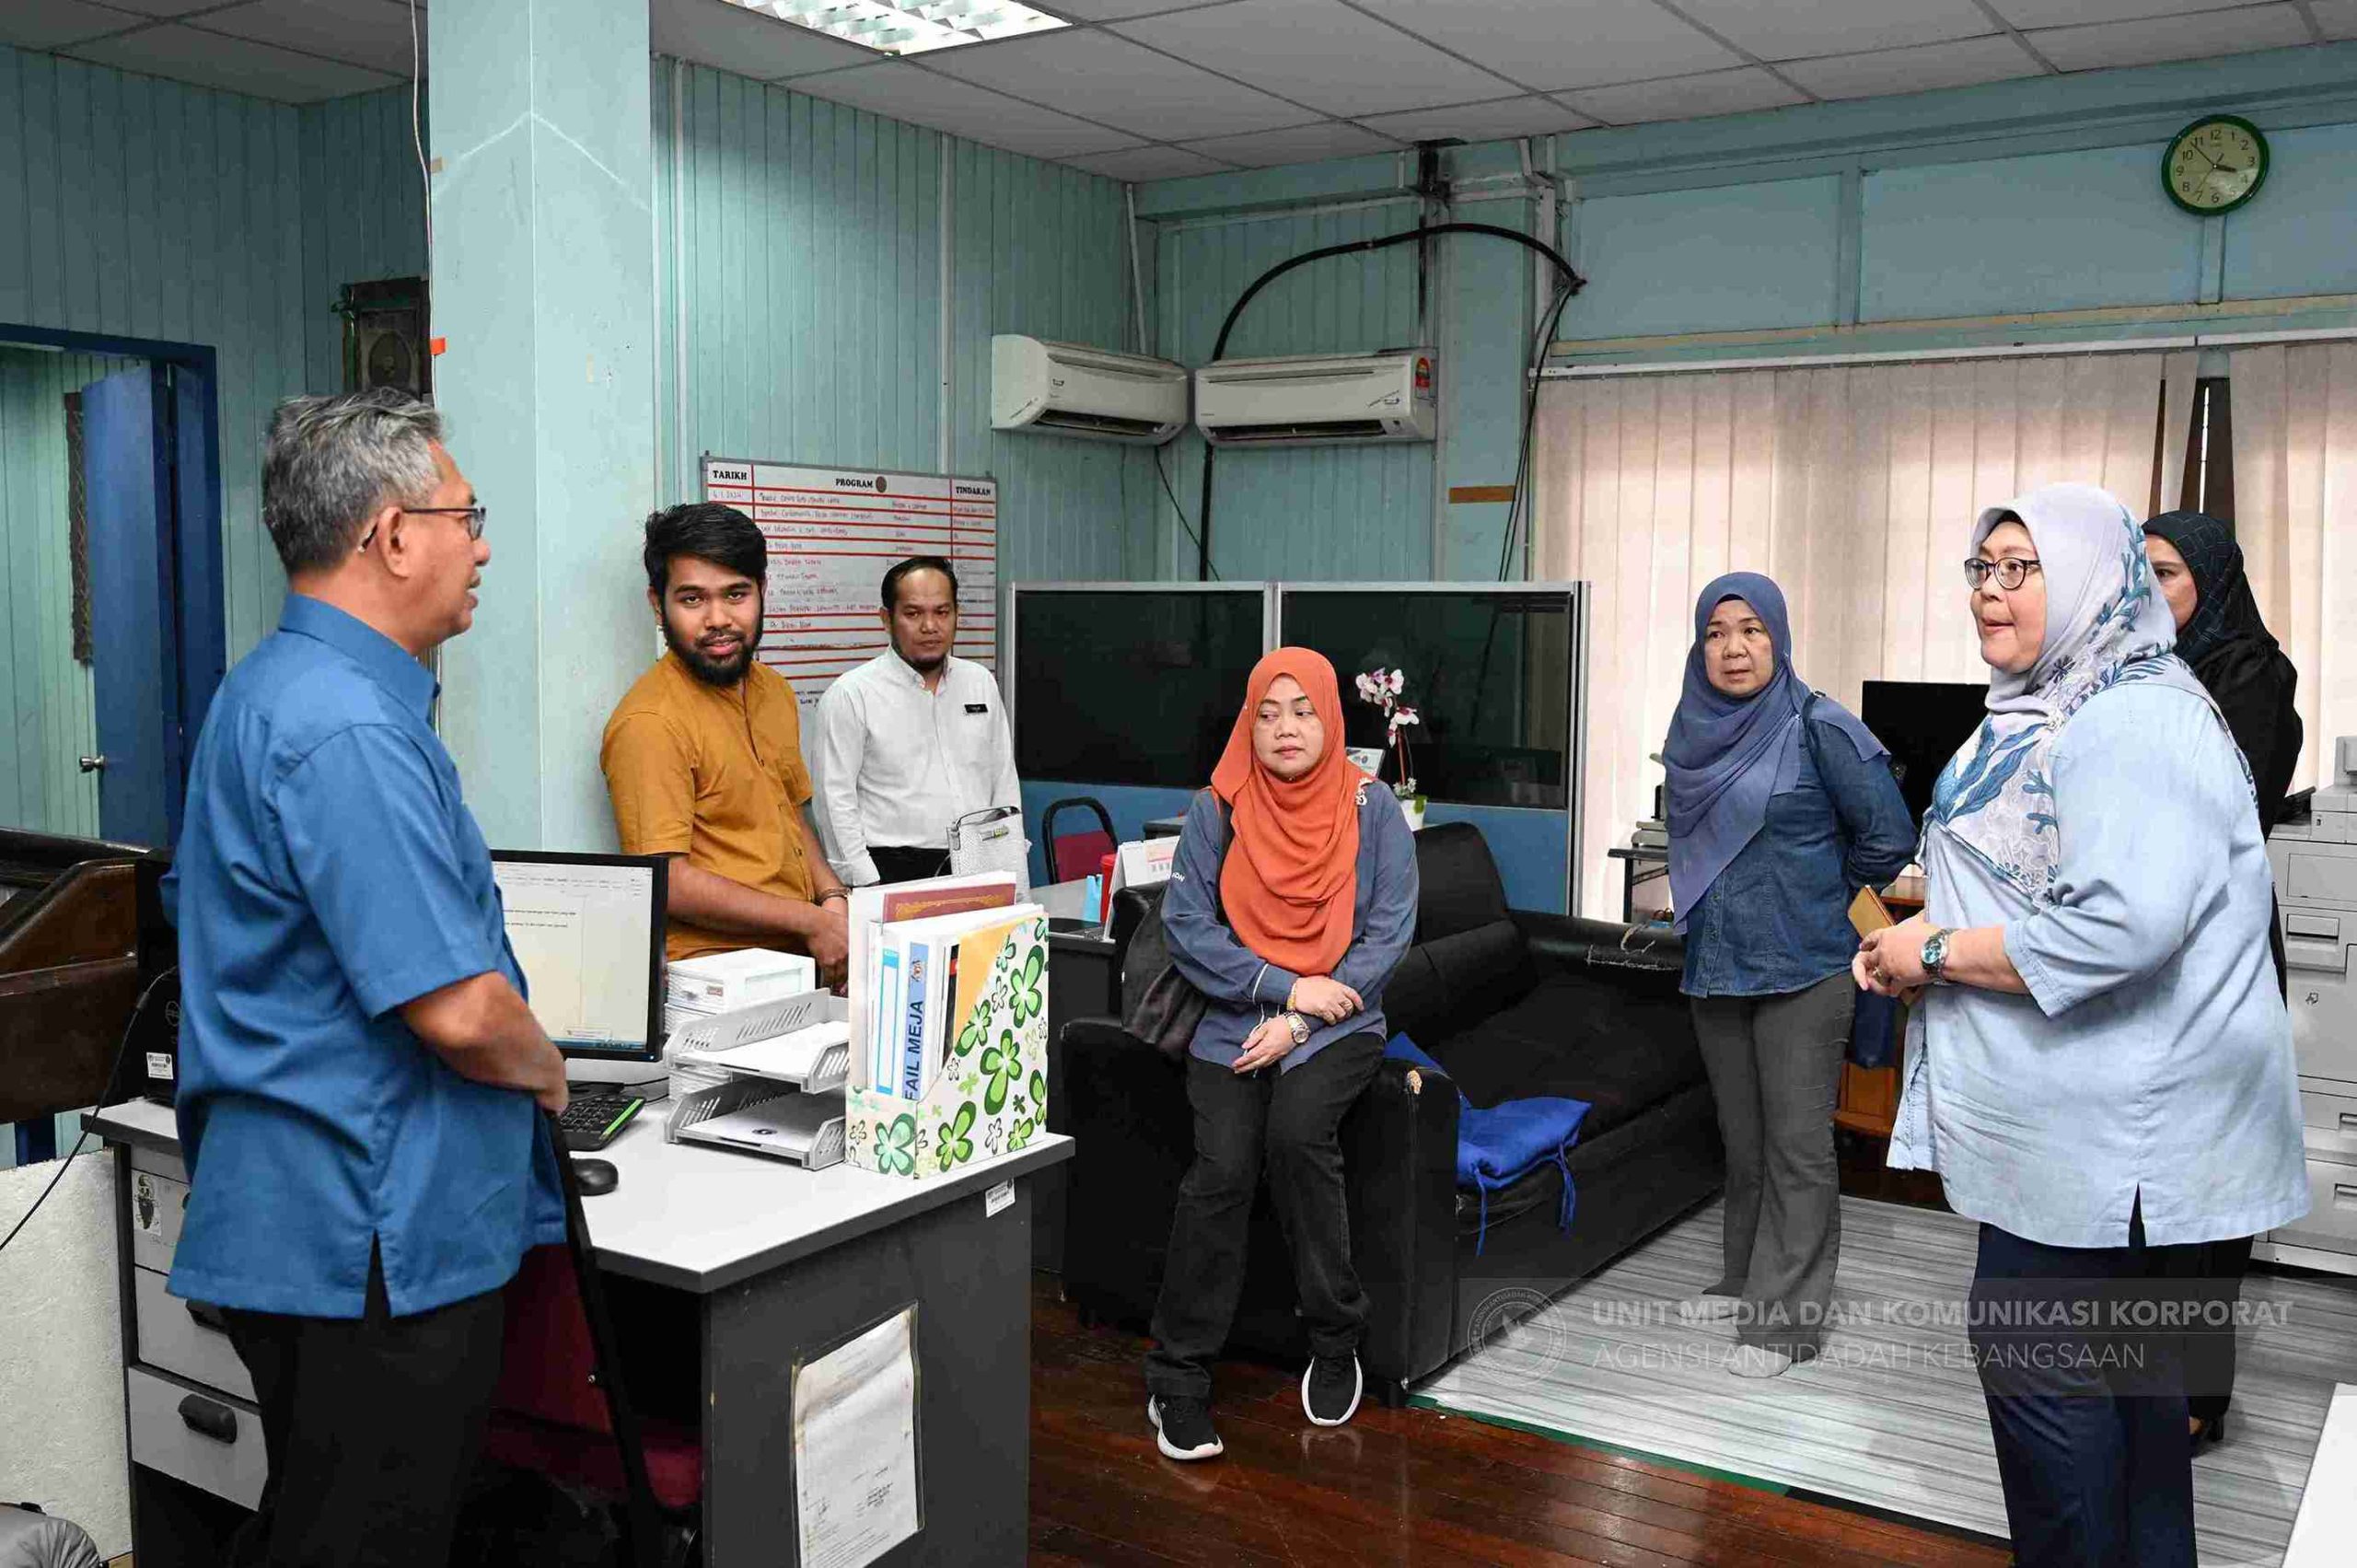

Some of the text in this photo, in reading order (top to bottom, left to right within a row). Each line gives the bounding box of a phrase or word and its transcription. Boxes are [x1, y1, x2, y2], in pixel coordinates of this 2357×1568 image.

[2211, 129, 2222, 140] 12
[2240, 139, 2249, 151] 2
[2182, 149, 2193, 161] 10
[2247, 157, 2256, 168] 3
[2176, 166, 2185, 177] 9
[2182, 181, 2190, 192] 8
[2195, 191, 2203, 202] 7
[2211, 192, 2220, 203] 6
[713, 470, 748, 481] TARIKH
[835, 477, 873, 489] PROGRAM
[955, 486, 992, 496] TINDAKAN
[905, 1000, 923, 1100] FAIL MEJA
